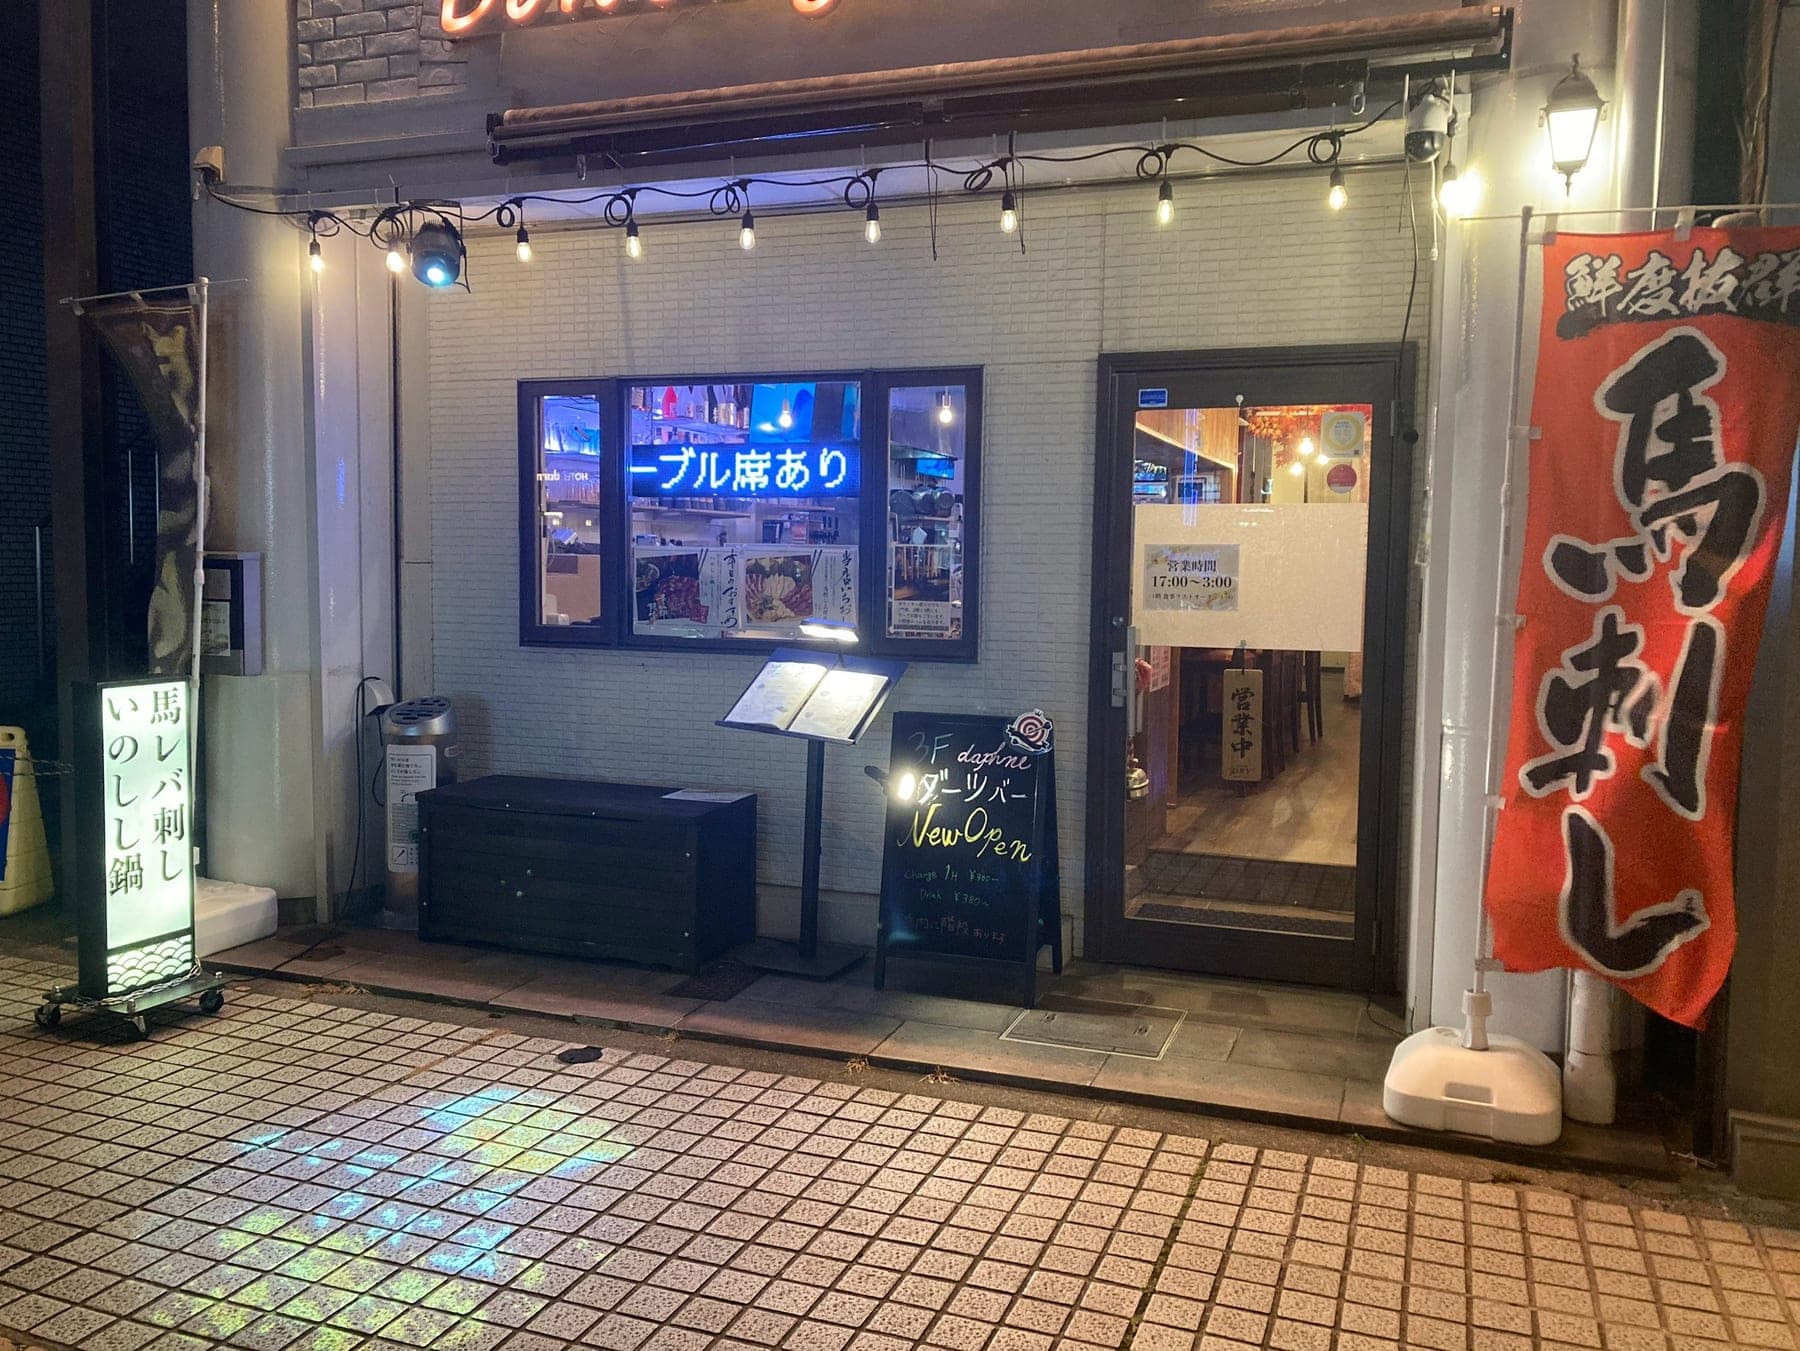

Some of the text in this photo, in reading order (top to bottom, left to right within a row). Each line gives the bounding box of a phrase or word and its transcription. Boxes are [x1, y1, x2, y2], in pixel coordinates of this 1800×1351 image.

[1152, 575, 1232, 588] 17:00〜3:00
[1166, 560, 1217, 573] 営業時間
[1520, 326, 1766, 979] 馬刺し
[1231, 687, 1256, 760] 営業中
[150, 687, 185, 882] 馬レバ刺し
[957, 742, 1032, 772] daphne
[107, 696, 144, 897] いのしし鍋
[917, 767, 1028, 806] ダーツバー
